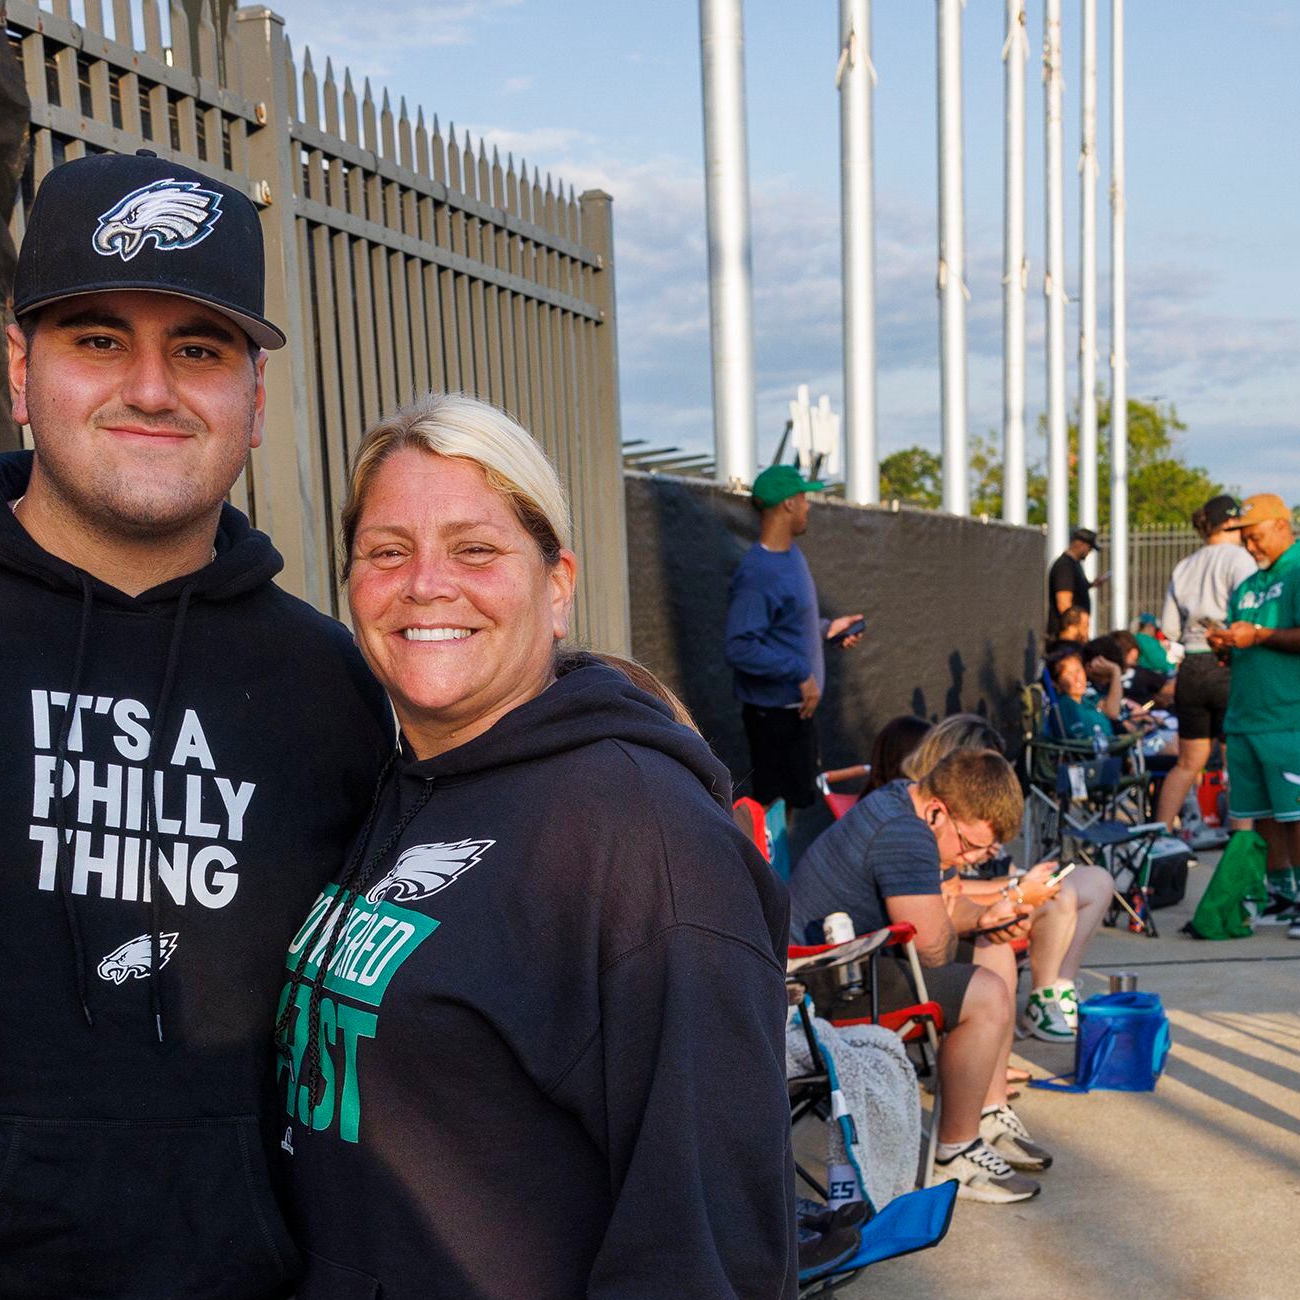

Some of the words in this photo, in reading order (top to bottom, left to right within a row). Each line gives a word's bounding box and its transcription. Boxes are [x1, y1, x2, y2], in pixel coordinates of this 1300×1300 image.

[31, 689, 152, 761] IT'S
[170, 709, 216, 770] A
[32, 755, 257, 842] PHILLY
[28, 824, 240, 910] THING
